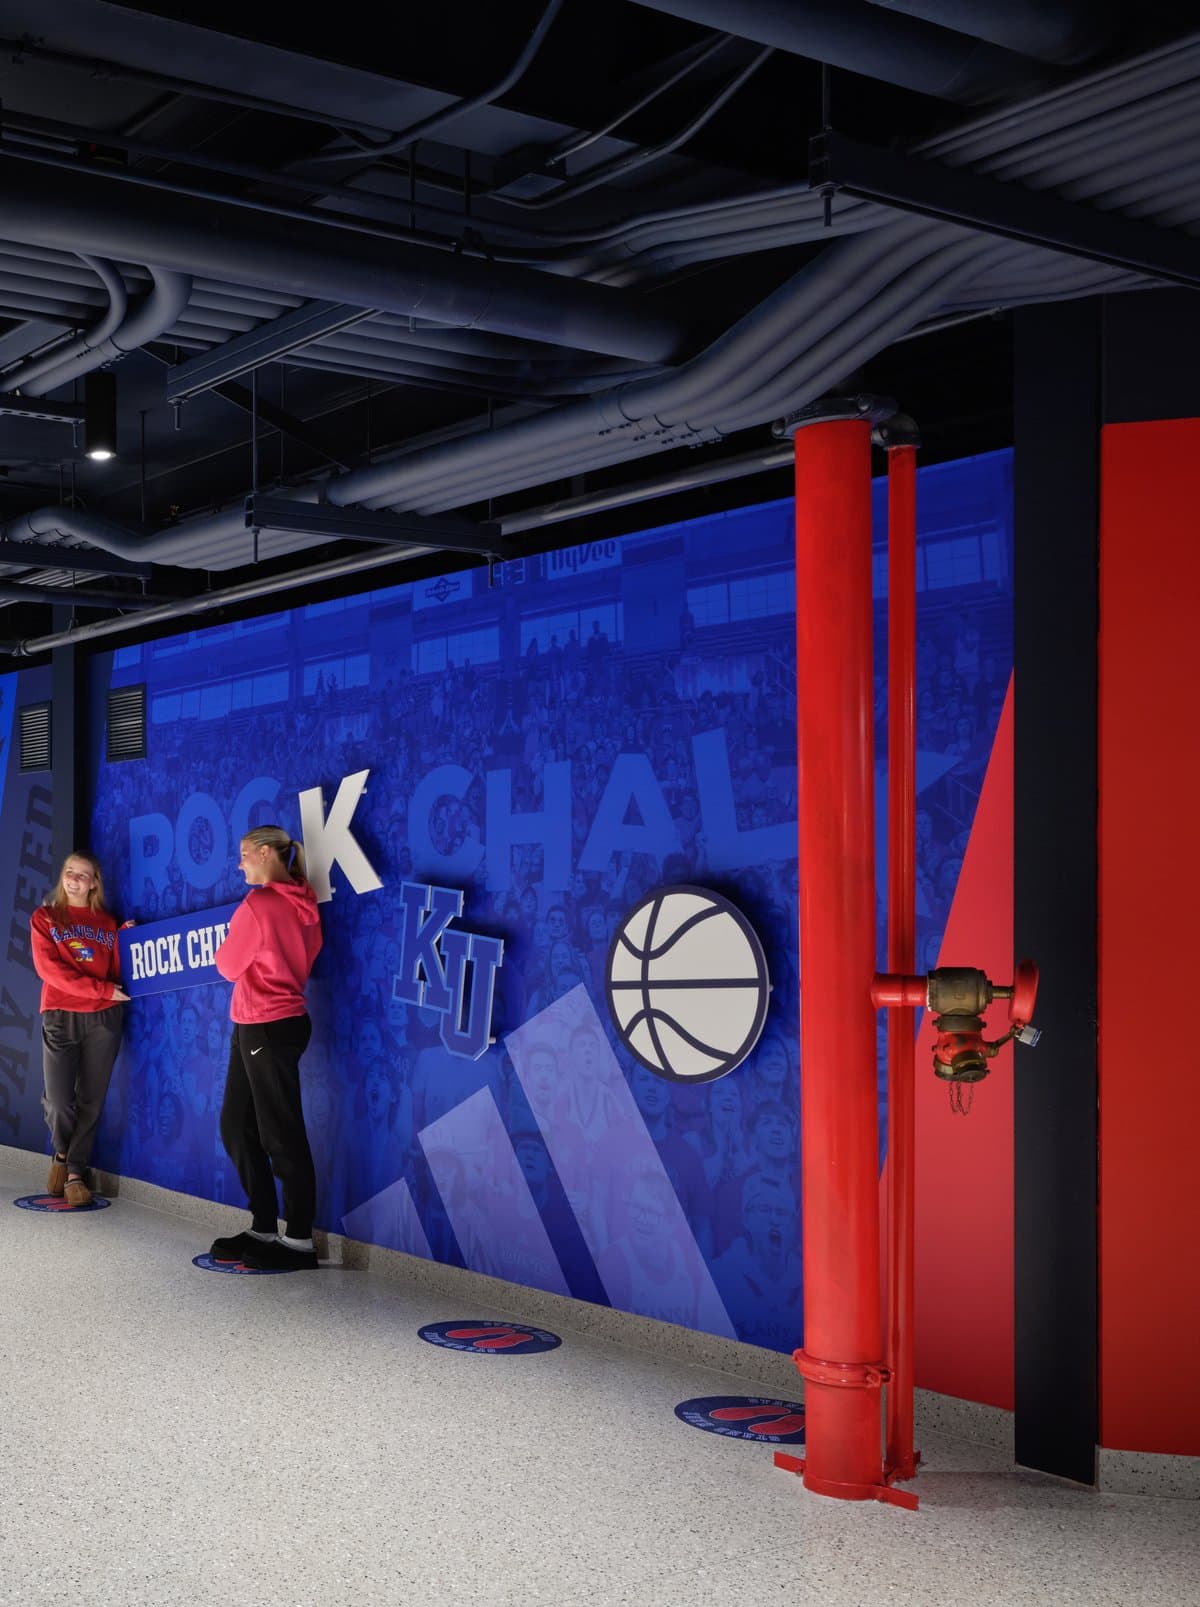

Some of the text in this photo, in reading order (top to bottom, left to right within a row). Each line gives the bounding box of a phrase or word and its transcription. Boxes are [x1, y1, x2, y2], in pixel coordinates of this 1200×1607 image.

[128, 768, 384, 904] ROCK
[49, 924, 115, 950] KANSAS
[130, 922, 231, 980] ROCK CHA
[392, 881, 504, 1062] KU
